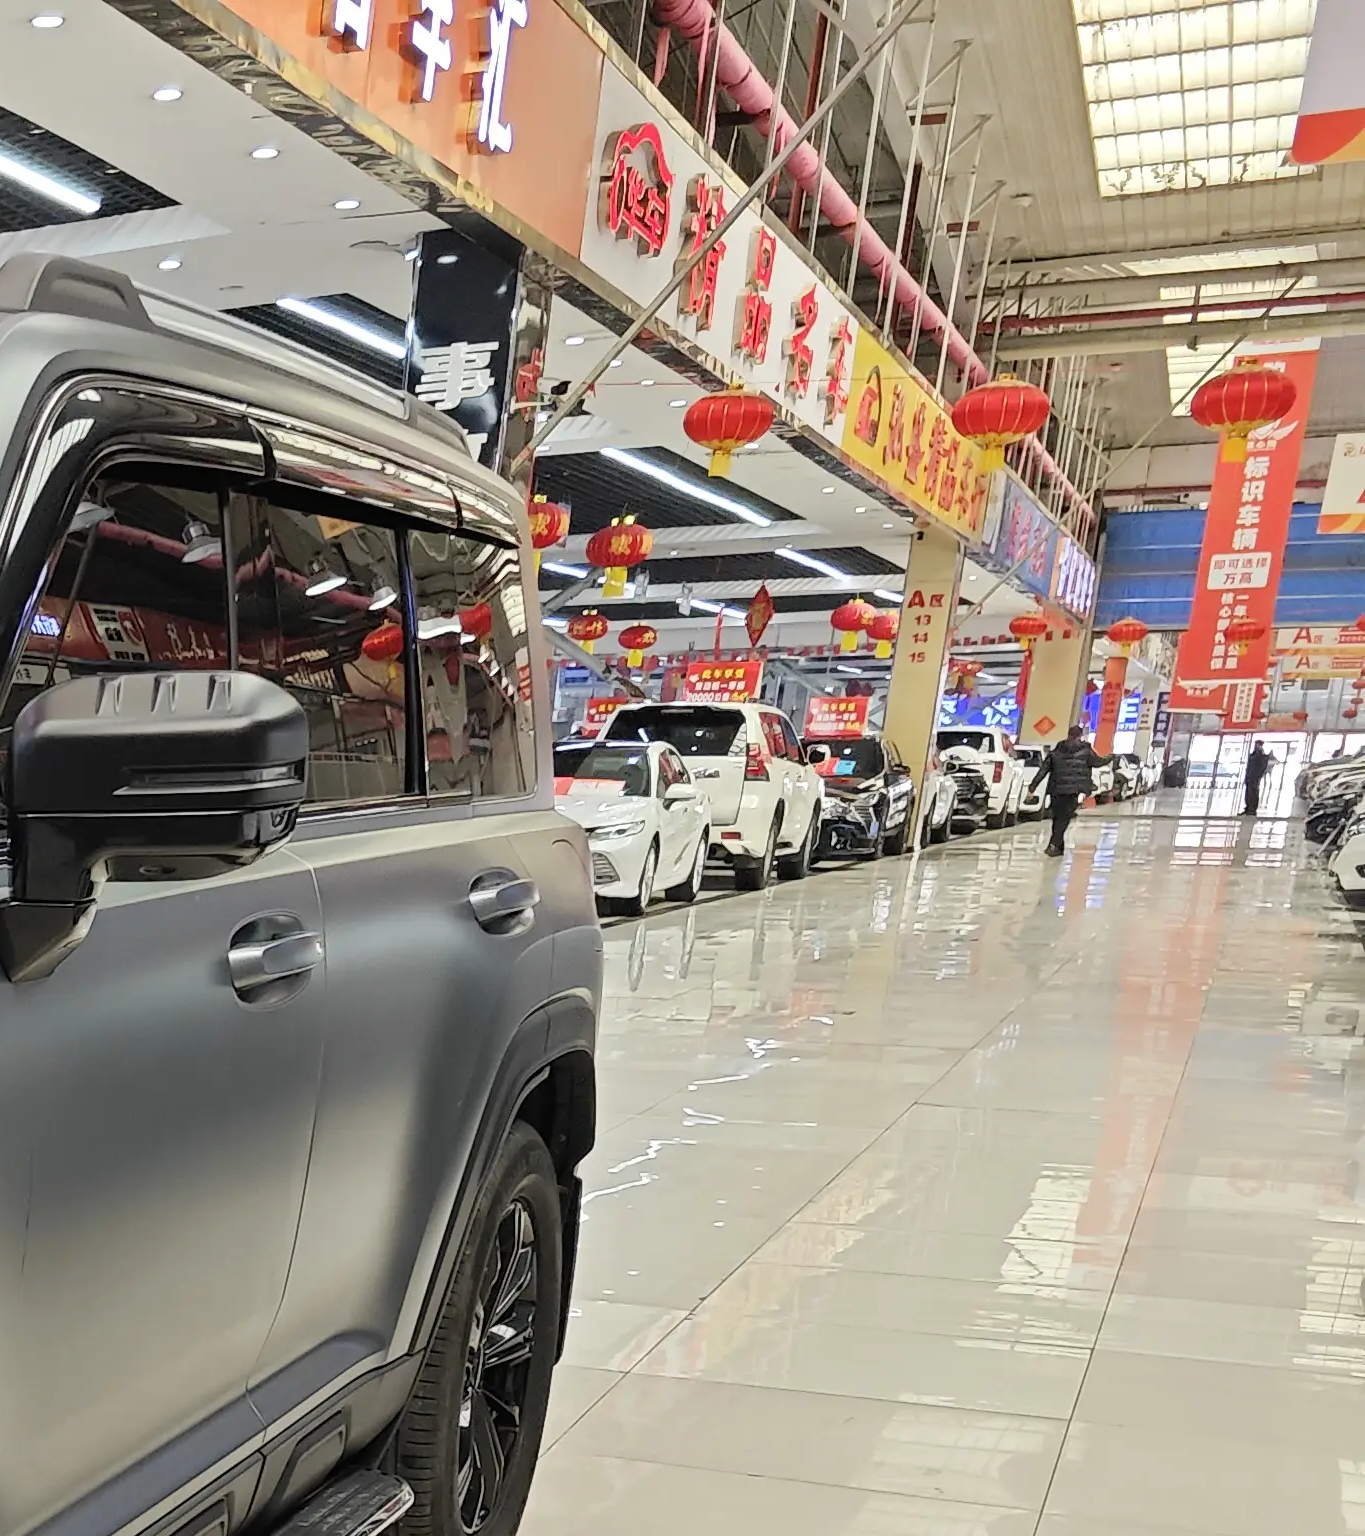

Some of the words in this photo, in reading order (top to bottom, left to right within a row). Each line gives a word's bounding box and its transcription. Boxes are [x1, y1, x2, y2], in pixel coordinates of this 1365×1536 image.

[1232, 456, 1270, 550] 标识车辆
[915, 615, 932, 626] 13
[909, 652, 926, 663] 15
